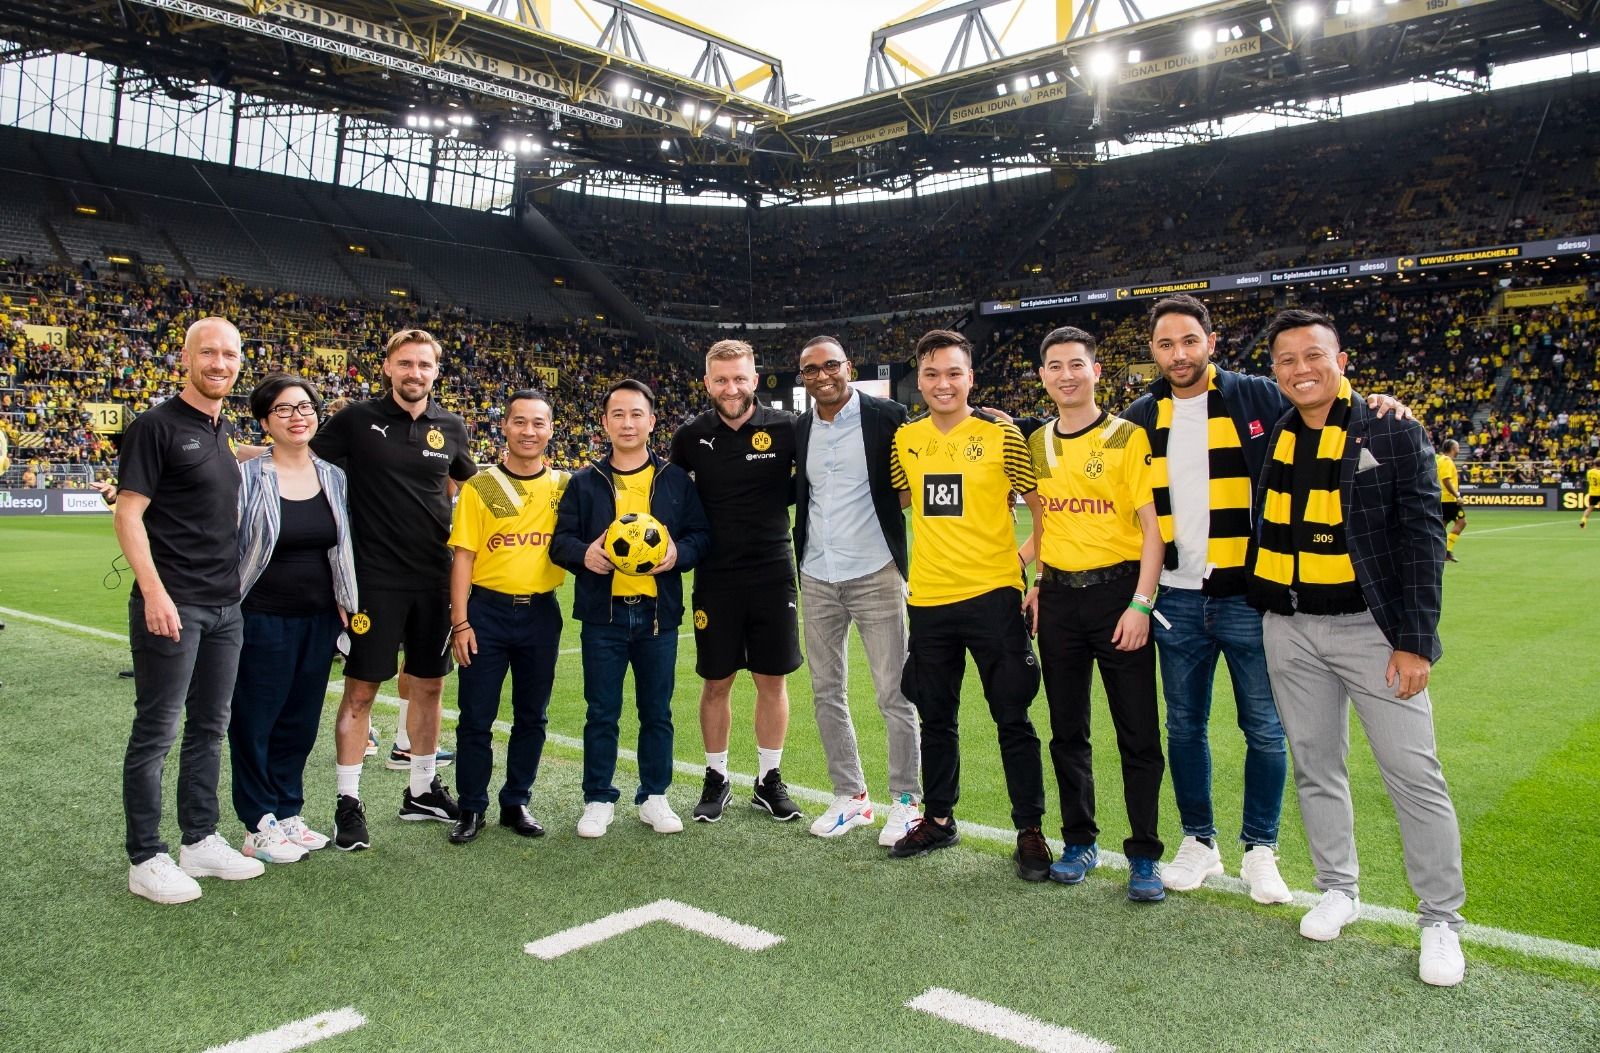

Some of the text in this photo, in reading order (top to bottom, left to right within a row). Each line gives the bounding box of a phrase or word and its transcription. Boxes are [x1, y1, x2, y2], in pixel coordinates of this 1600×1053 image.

[1164, 54, 1200, 70] IDUNA
[1224, 39, 1257, 56] PARK
[511, 63, 673, 123] DORTMUND
[952, 85, 1064, 120] SIGNAL IDUNA PARK
[1556, 240, 1588, 250] adesso
[1420, 248, 1519, 265] WWW.IT-SPIELMACHER.DE
[1359, 262, 1385, 271] adesso
[1236, 275, 1259, 285] adesso
[1272, 273, 1283, 281] Der
[1283, 270, 1321, 281] Spielmacher
[1328, 267, 1339, 275] der
[1133, 281, 1208, 295] WWW.IT-SPIELMACHER.DE
[46, 331, 63, 346] 13
[331, 354, 344, 366] 12
[546, 371, 555, 383] 11
[879, 367, 889, 376] 1&1
[100, 410, 118, 425] 13
[754, 434, 769, 445] BVB
[966, 443, 983, 457] BVB
[1086, 459, 1103, 473] BVB
[926, 483, 959, 505] 1&1
[1462, 495, 1544, 505] SCHWARZGELB
[0, 495, 43, 508] desso
[67, 498, 97, 508] Unser
[1312, 533, 1334, 543] 1909
[353, 615, 368, 629] BVB
